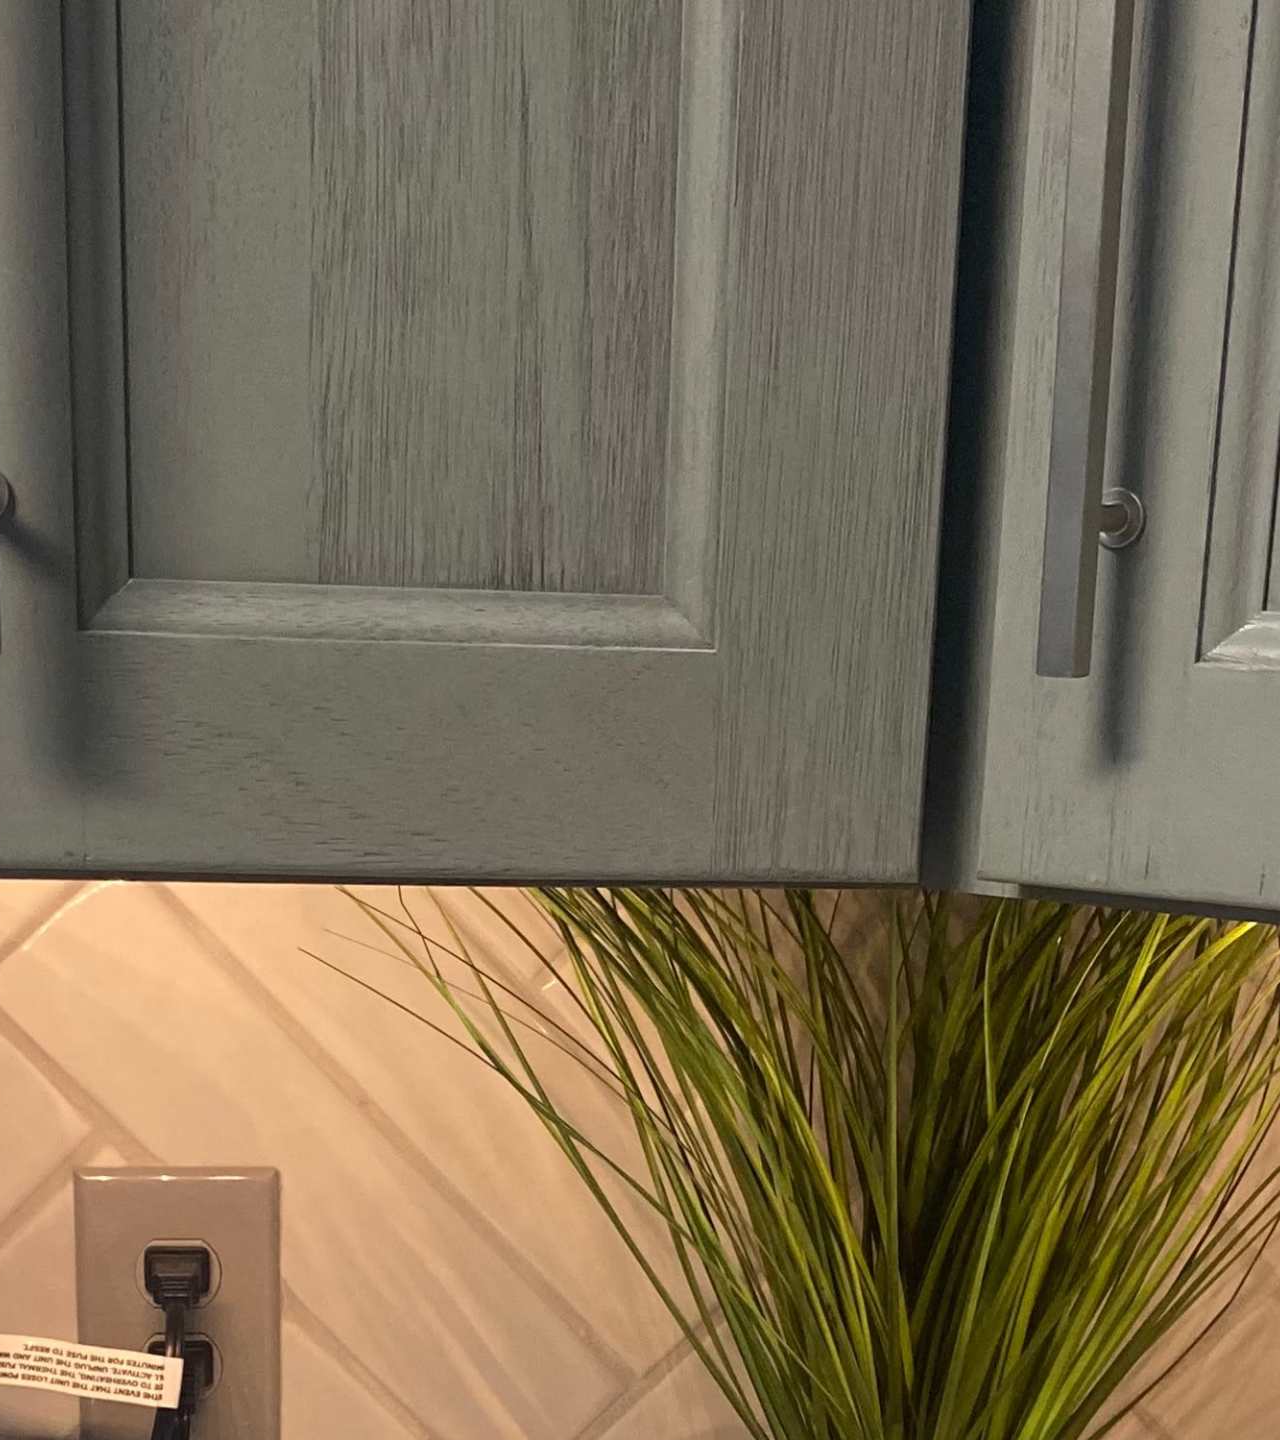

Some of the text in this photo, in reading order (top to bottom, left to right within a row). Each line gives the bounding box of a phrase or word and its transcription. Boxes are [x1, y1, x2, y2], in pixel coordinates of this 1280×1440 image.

[12, 1352, 31, 1360] AND
[51, 1348, 64, 1356] TO
[66, 1351, 88, 1361] FUSE
[33, 1355, 54, 1364] UNIT
[56, 1358, 72, 1368] THE
[90, 1354, 105, 1363] THE
[107, 1357, 125, 1366] FOR
[19, 1363, 57, 1375] THERMAL
[74, 1362, 108, 1373] UNPLUG
[21, 1373, 48, 1383] LOSES
[60, 1370, 76, 1379] THE
[50, 1377, 70, 1387] UNIT
[72, 1382, 88, 1390] THE
[140, 1382, 152, 1390] TO
[91, 1385, 111, 1394] THAT
[113, 1387, 141, 1398] EVENT
